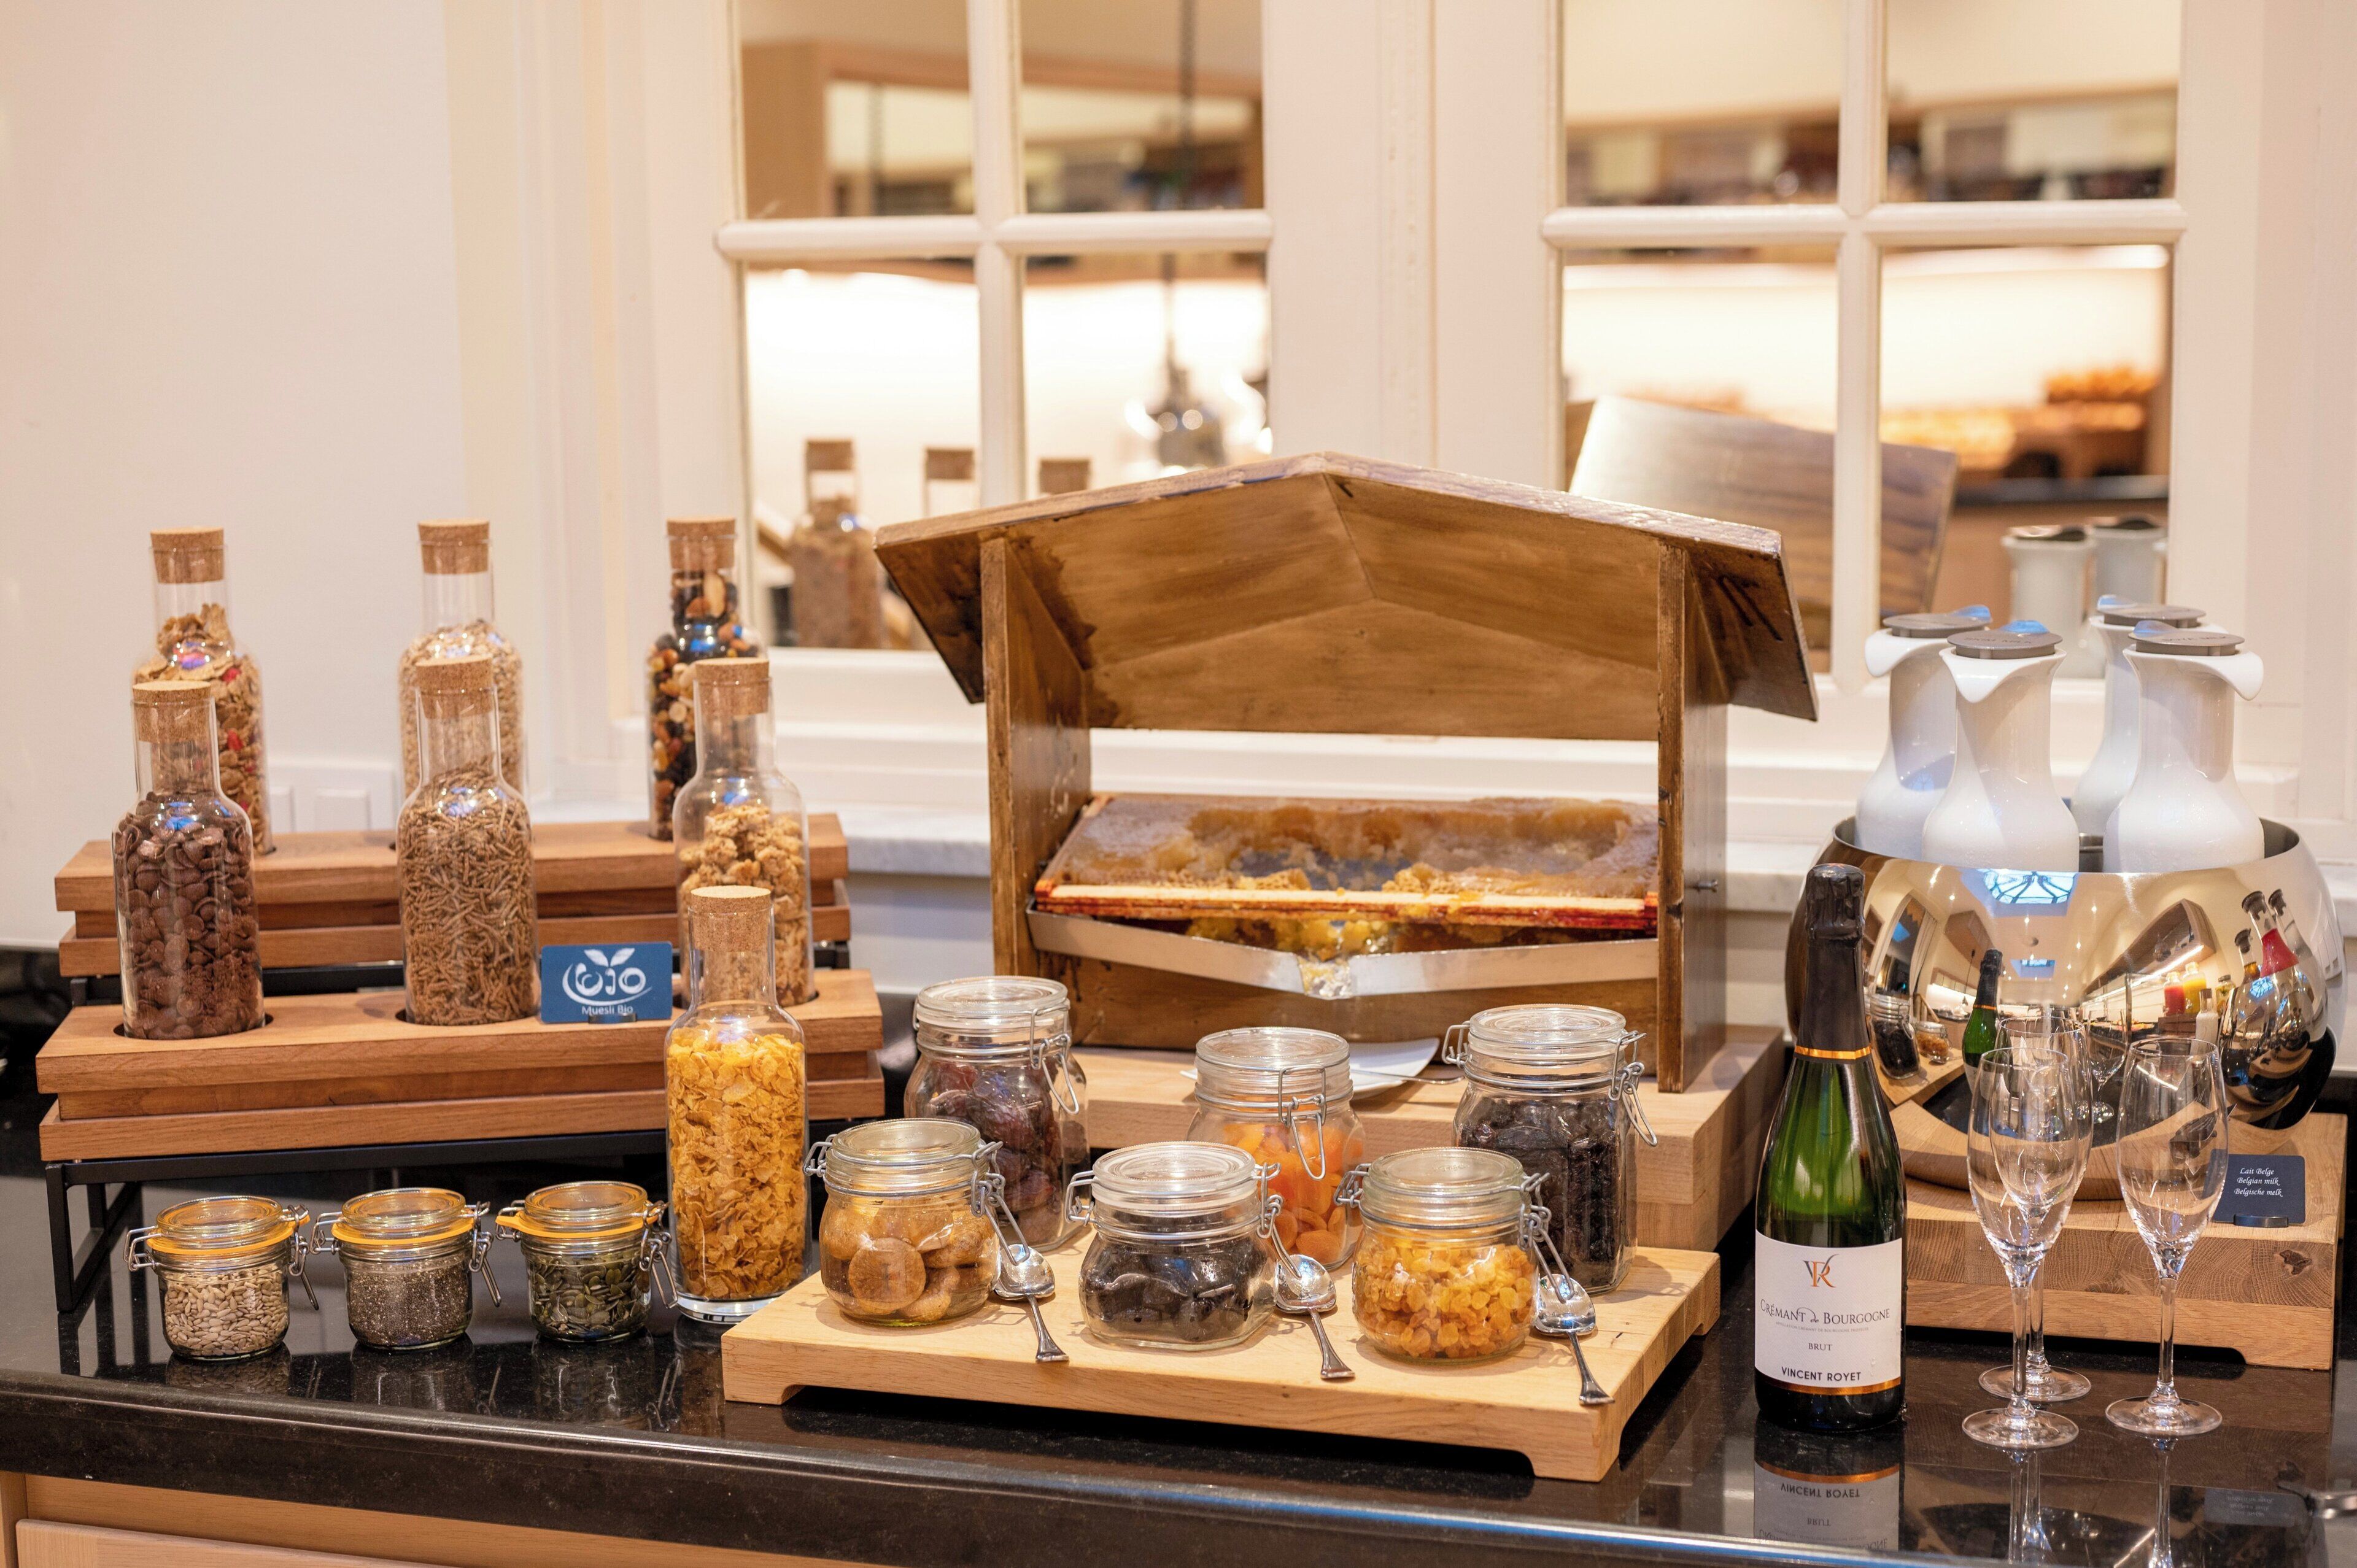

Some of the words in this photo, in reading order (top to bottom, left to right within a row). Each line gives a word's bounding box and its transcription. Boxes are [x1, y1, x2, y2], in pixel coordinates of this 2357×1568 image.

[581, 1005, 614, 1015] Muesli
[617, 1005, 633, 1014] Bio
[2256, 1167, 2275, 1176] Belge
[2237, 1176, 2262, 1186] Belgian
[2264, 1177, 2280, 1186] milk
[2234, 1188, 2265, 1197] Belgische
[2266, 1188, 2283, 1197] melk
[1823, 1308, 1890, 1325] BOURGOGNE
[1808, 1342, 1833, 1351] BRUT
[1781, 1366, 1822, 1381] VINCENT
[1827, 1372, 1861, 1381] ROYET
